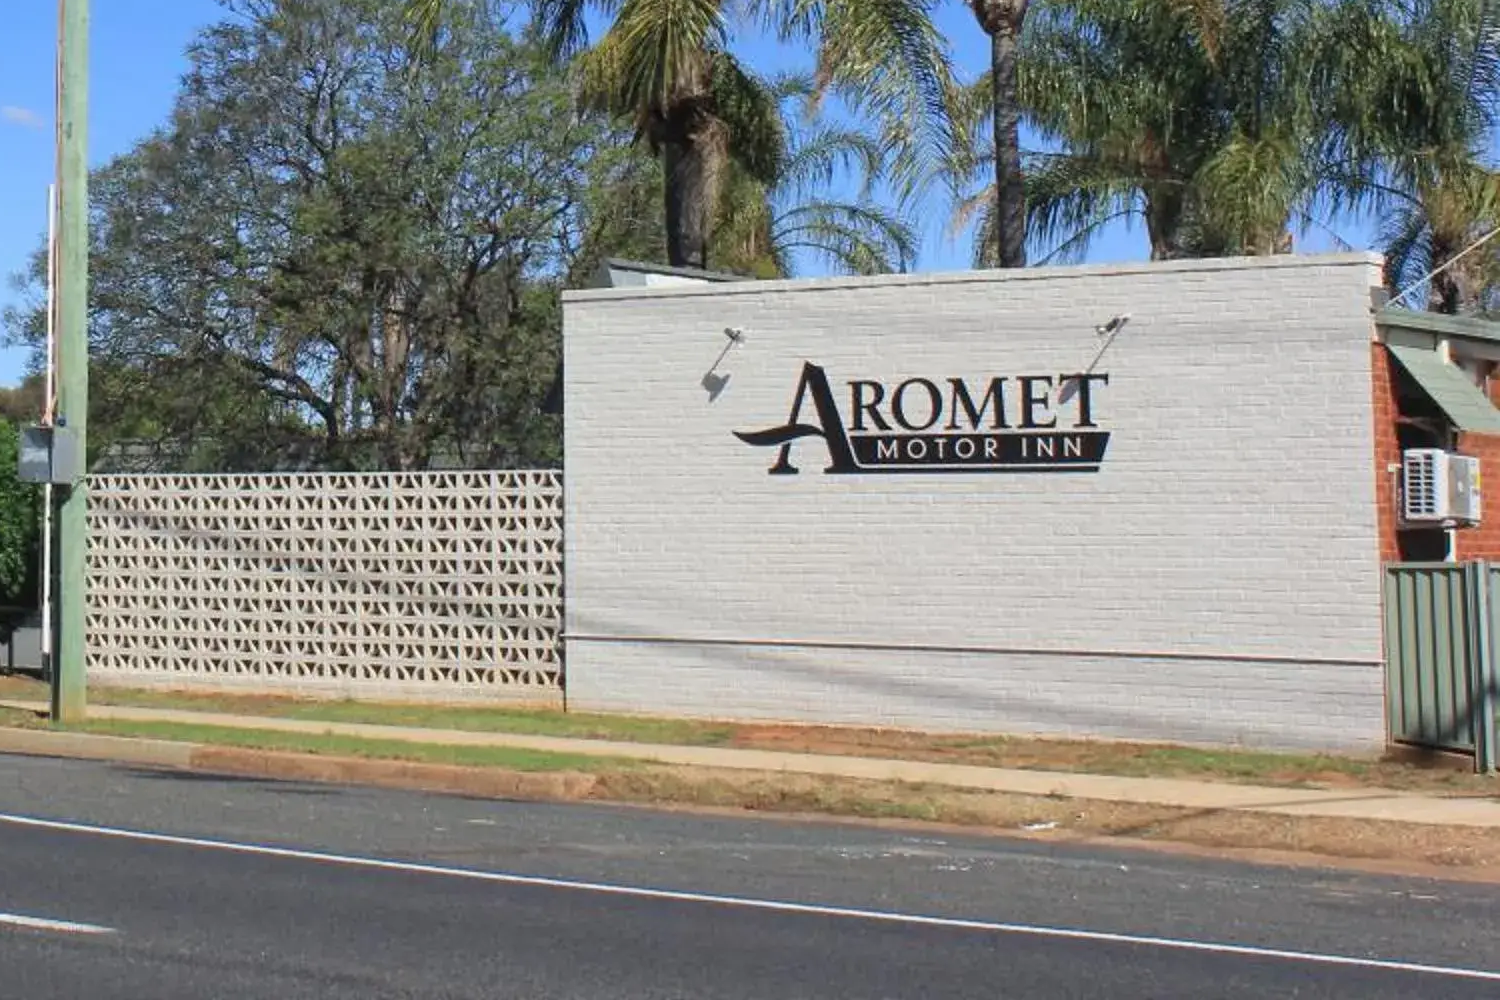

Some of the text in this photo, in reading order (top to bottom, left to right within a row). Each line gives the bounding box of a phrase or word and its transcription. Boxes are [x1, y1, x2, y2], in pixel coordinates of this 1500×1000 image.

[731, 360, 1109, 474] AROMET
[876, 436, 1083, 460] MOTOR INN
